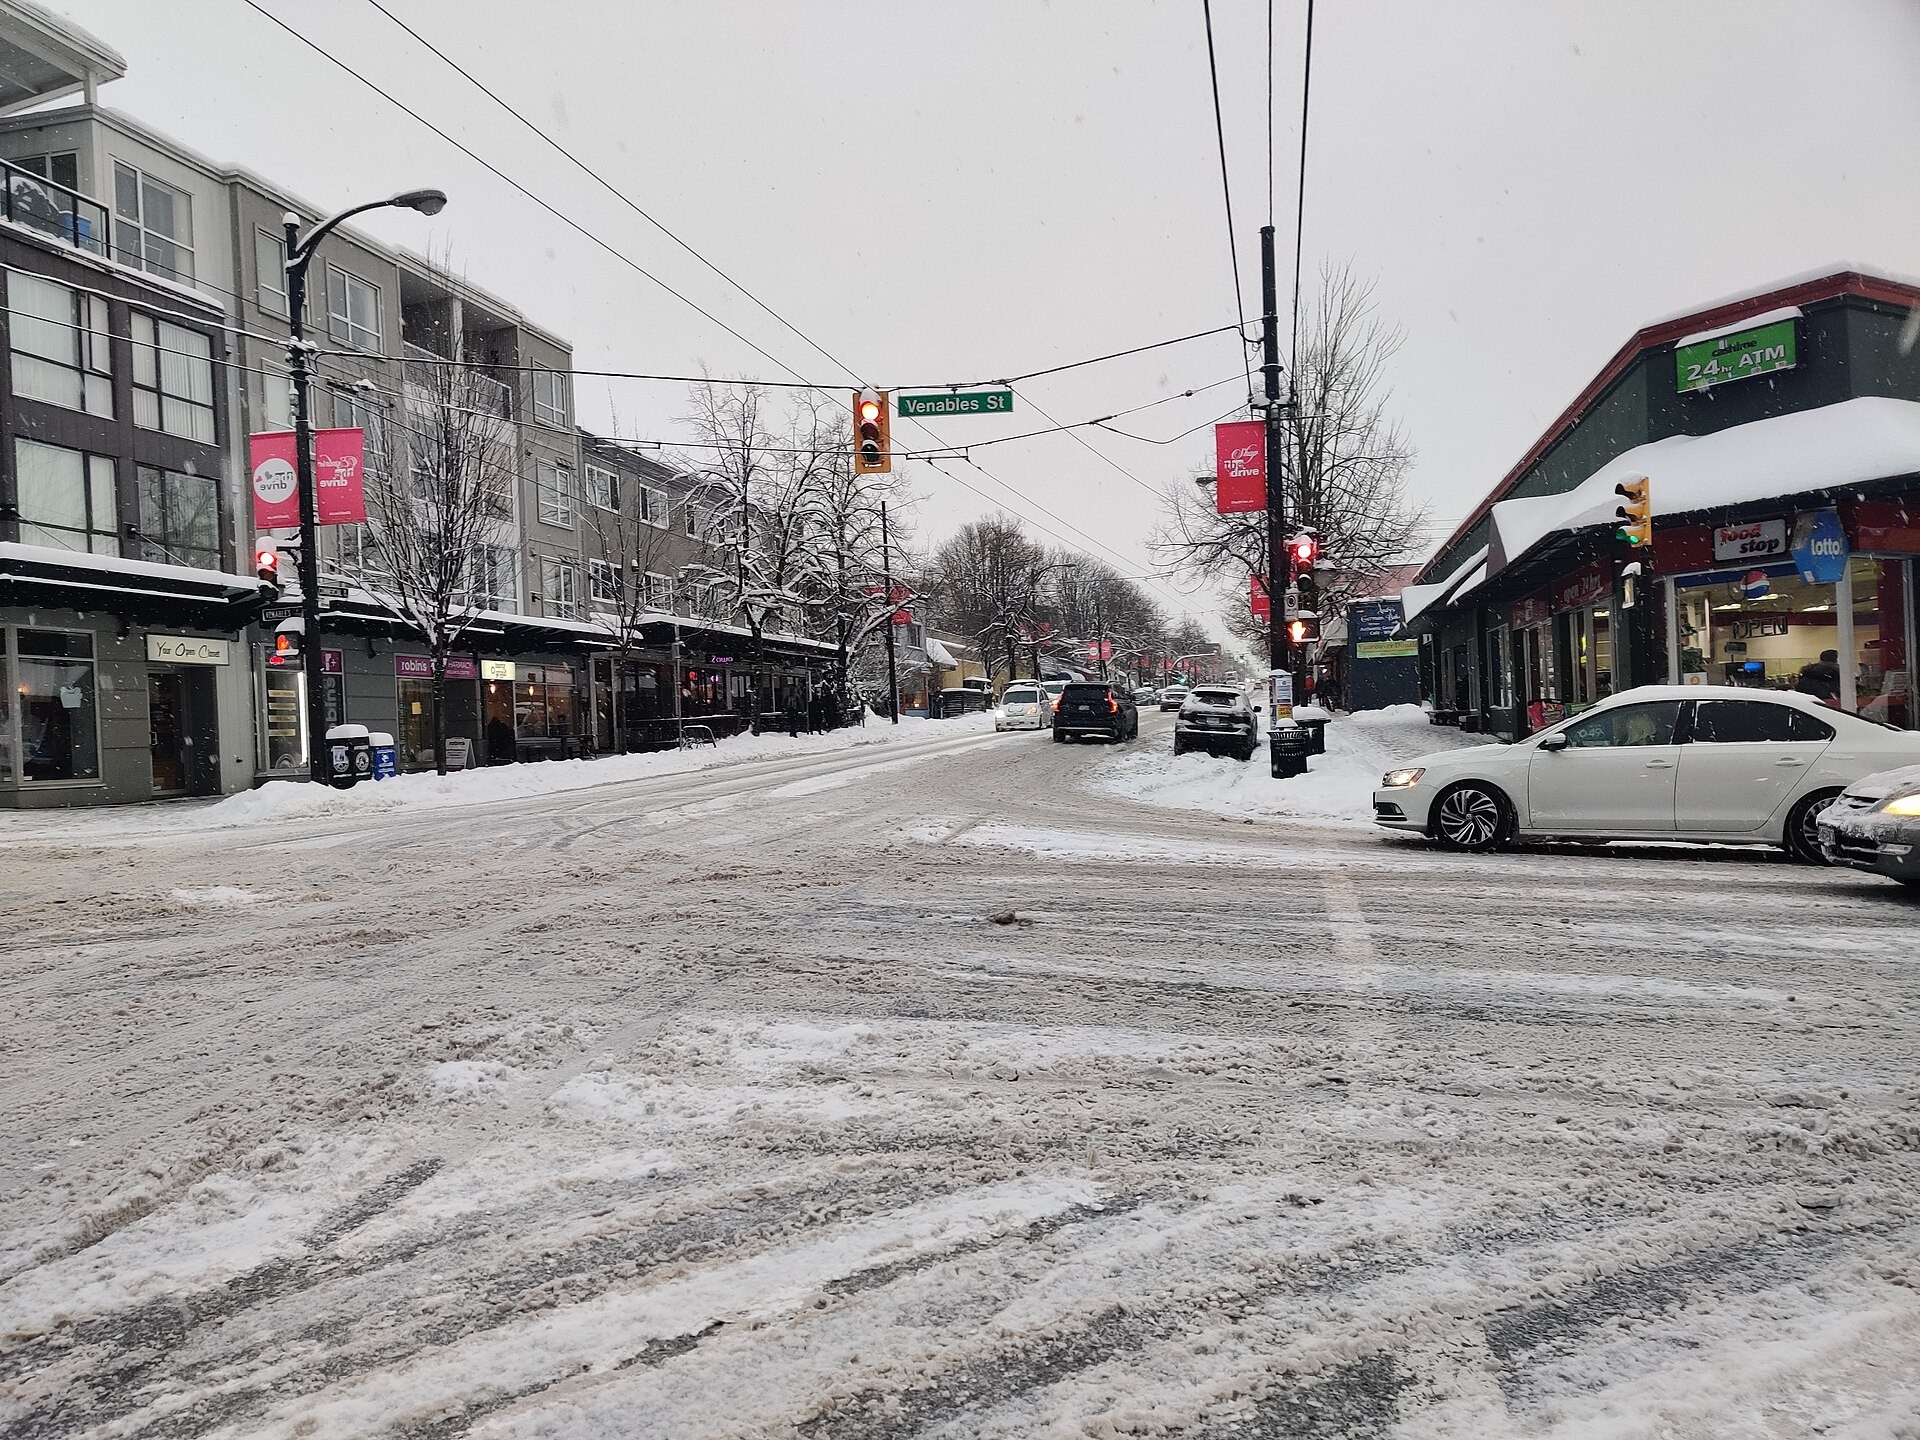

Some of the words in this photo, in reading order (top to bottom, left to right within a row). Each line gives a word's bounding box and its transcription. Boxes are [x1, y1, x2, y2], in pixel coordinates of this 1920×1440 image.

[1738, 345, 1785, 368] ATM
[906, 398, 979, 413] Venables
[986, 396, 1005, 410] St
[1231, 467, 1260, 477] drive
[1720, 524, 1762, 546] food
[1740, 538, 1779, 554] stop
[1732, 616, 1788, 639] OPEN
[157, 641, 172, 657] Your
[175, 643, 195, 657] Open
[198, 645, 220, 658] Closet
[401, 660, 428, 672] robin's
